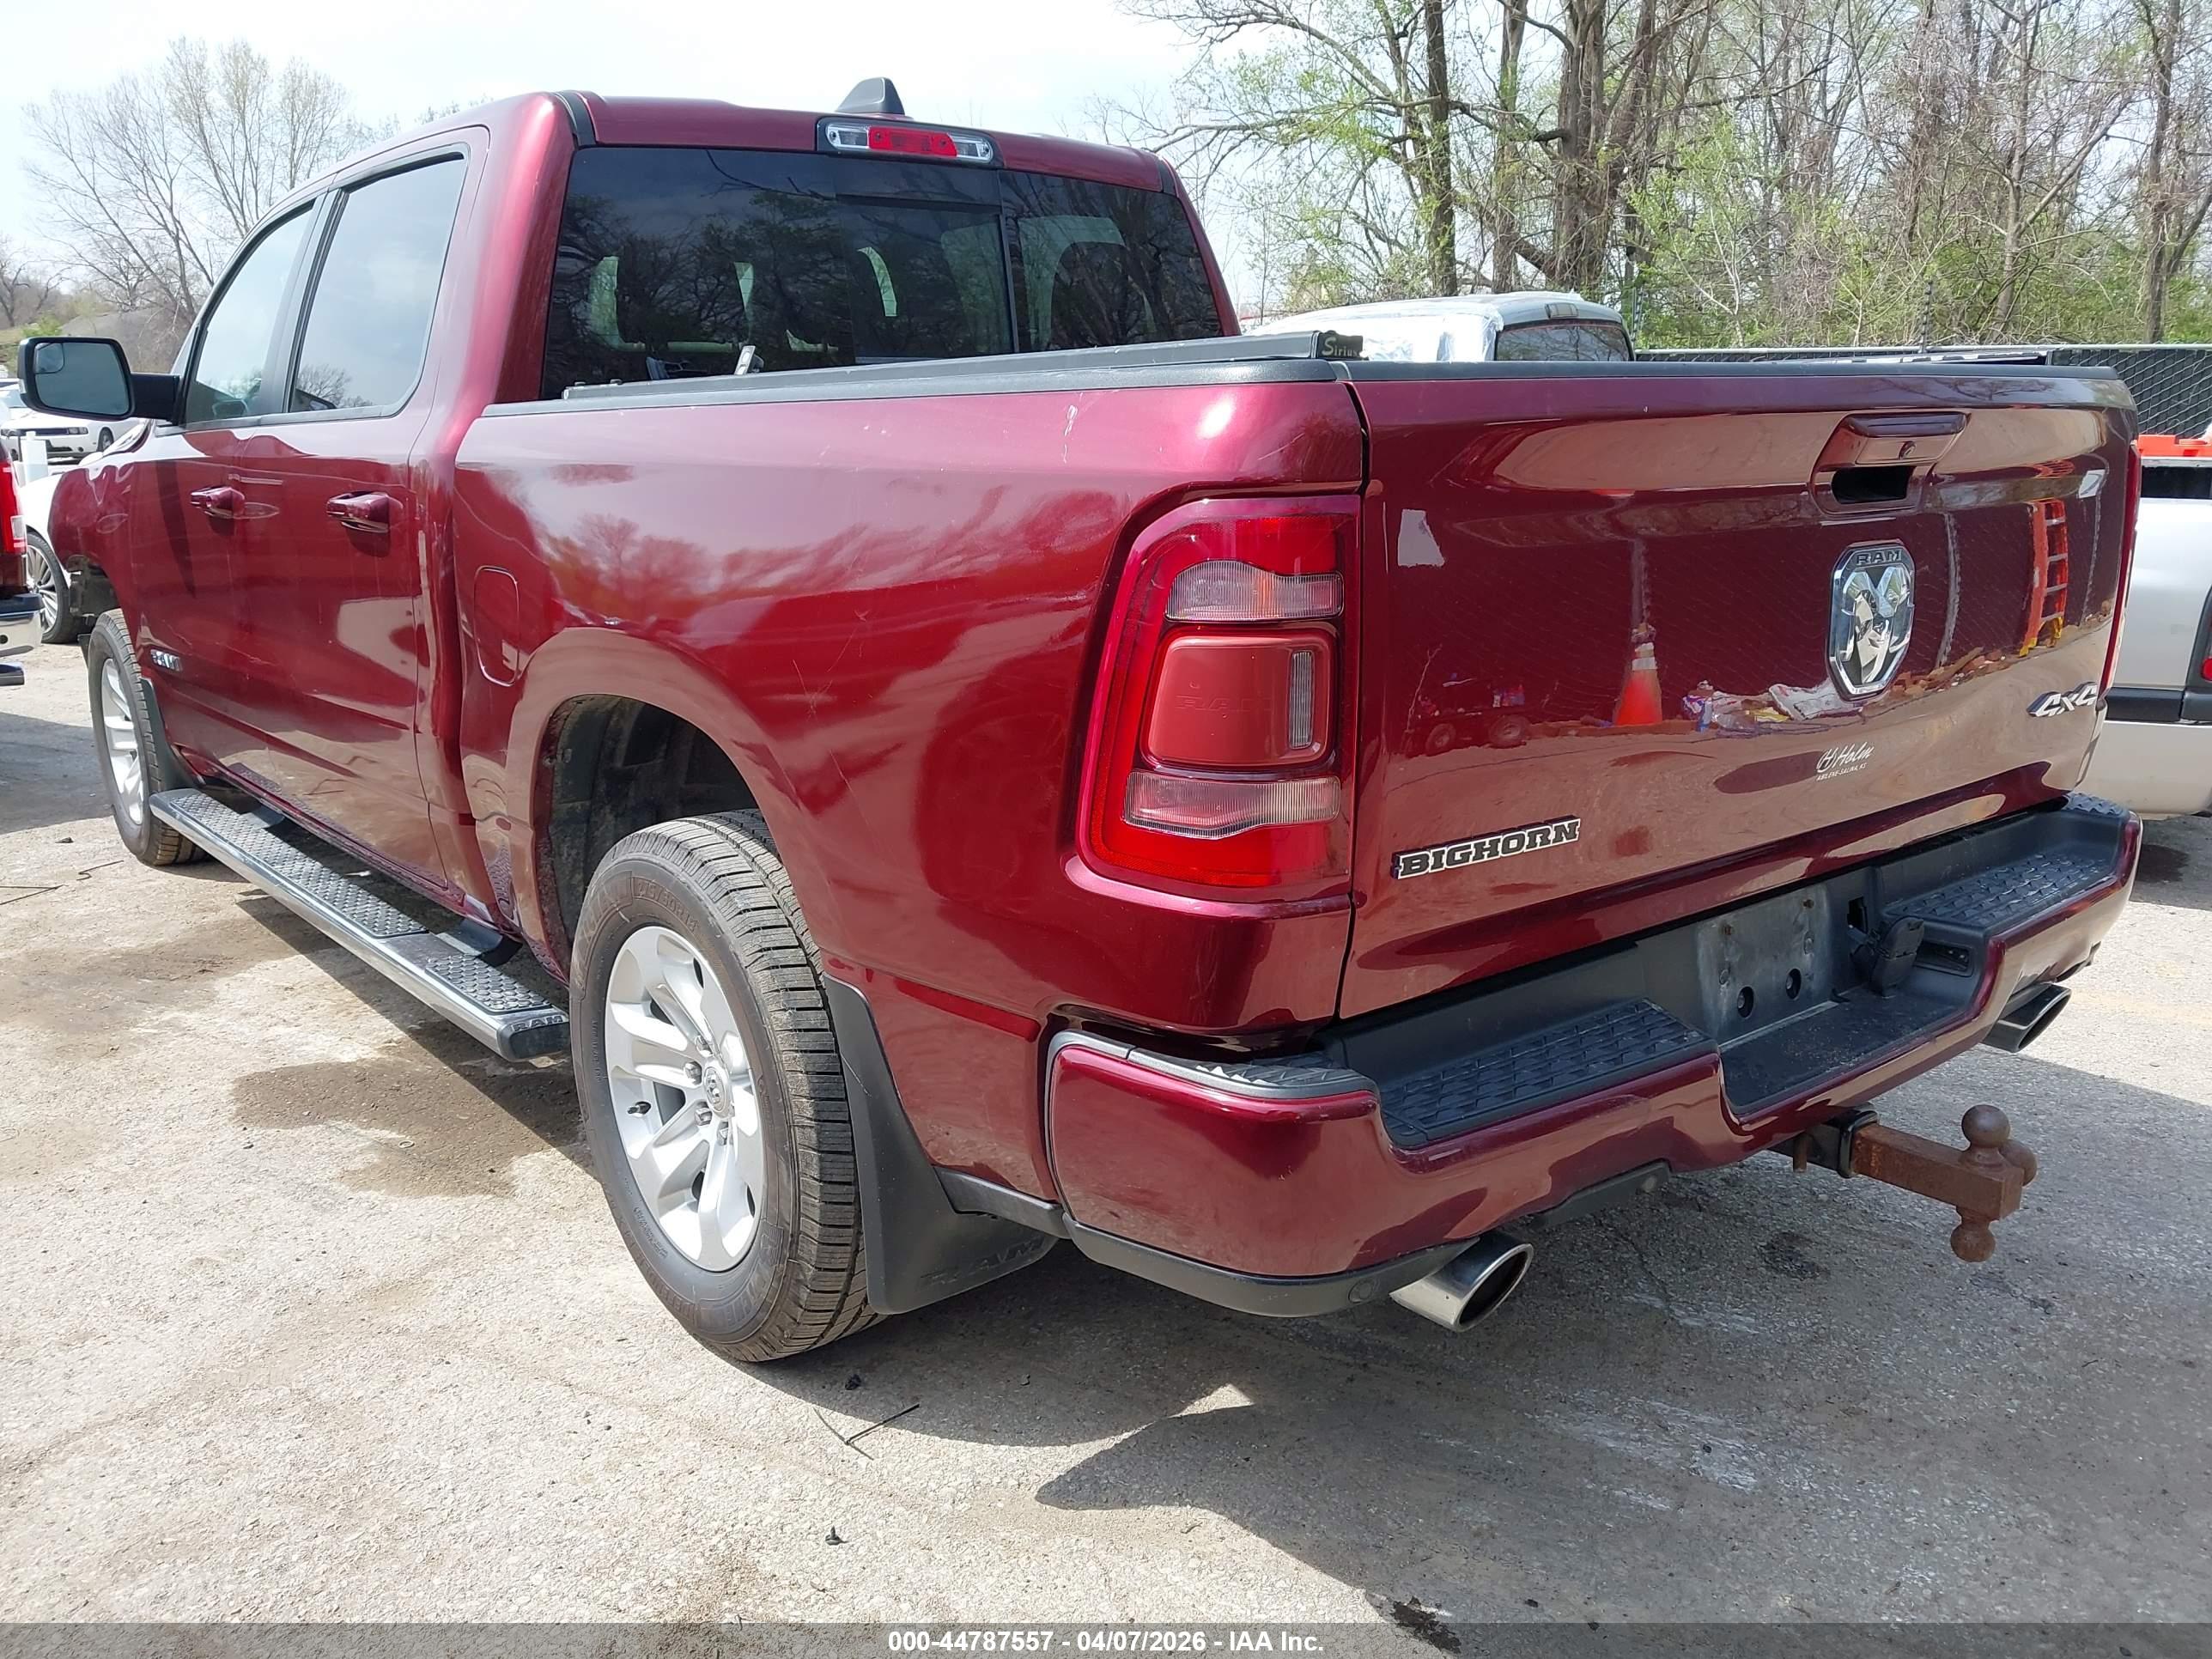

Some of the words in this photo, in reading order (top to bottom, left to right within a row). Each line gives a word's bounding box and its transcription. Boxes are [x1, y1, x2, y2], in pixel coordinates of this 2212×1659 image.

[1322, 336, 1358, 357] Sirius
[1856, 550, 1903, 566] RAM
[1393, 816, 1581, 879] BIGHORN
[511, 1014, 564, 1032] RAM
